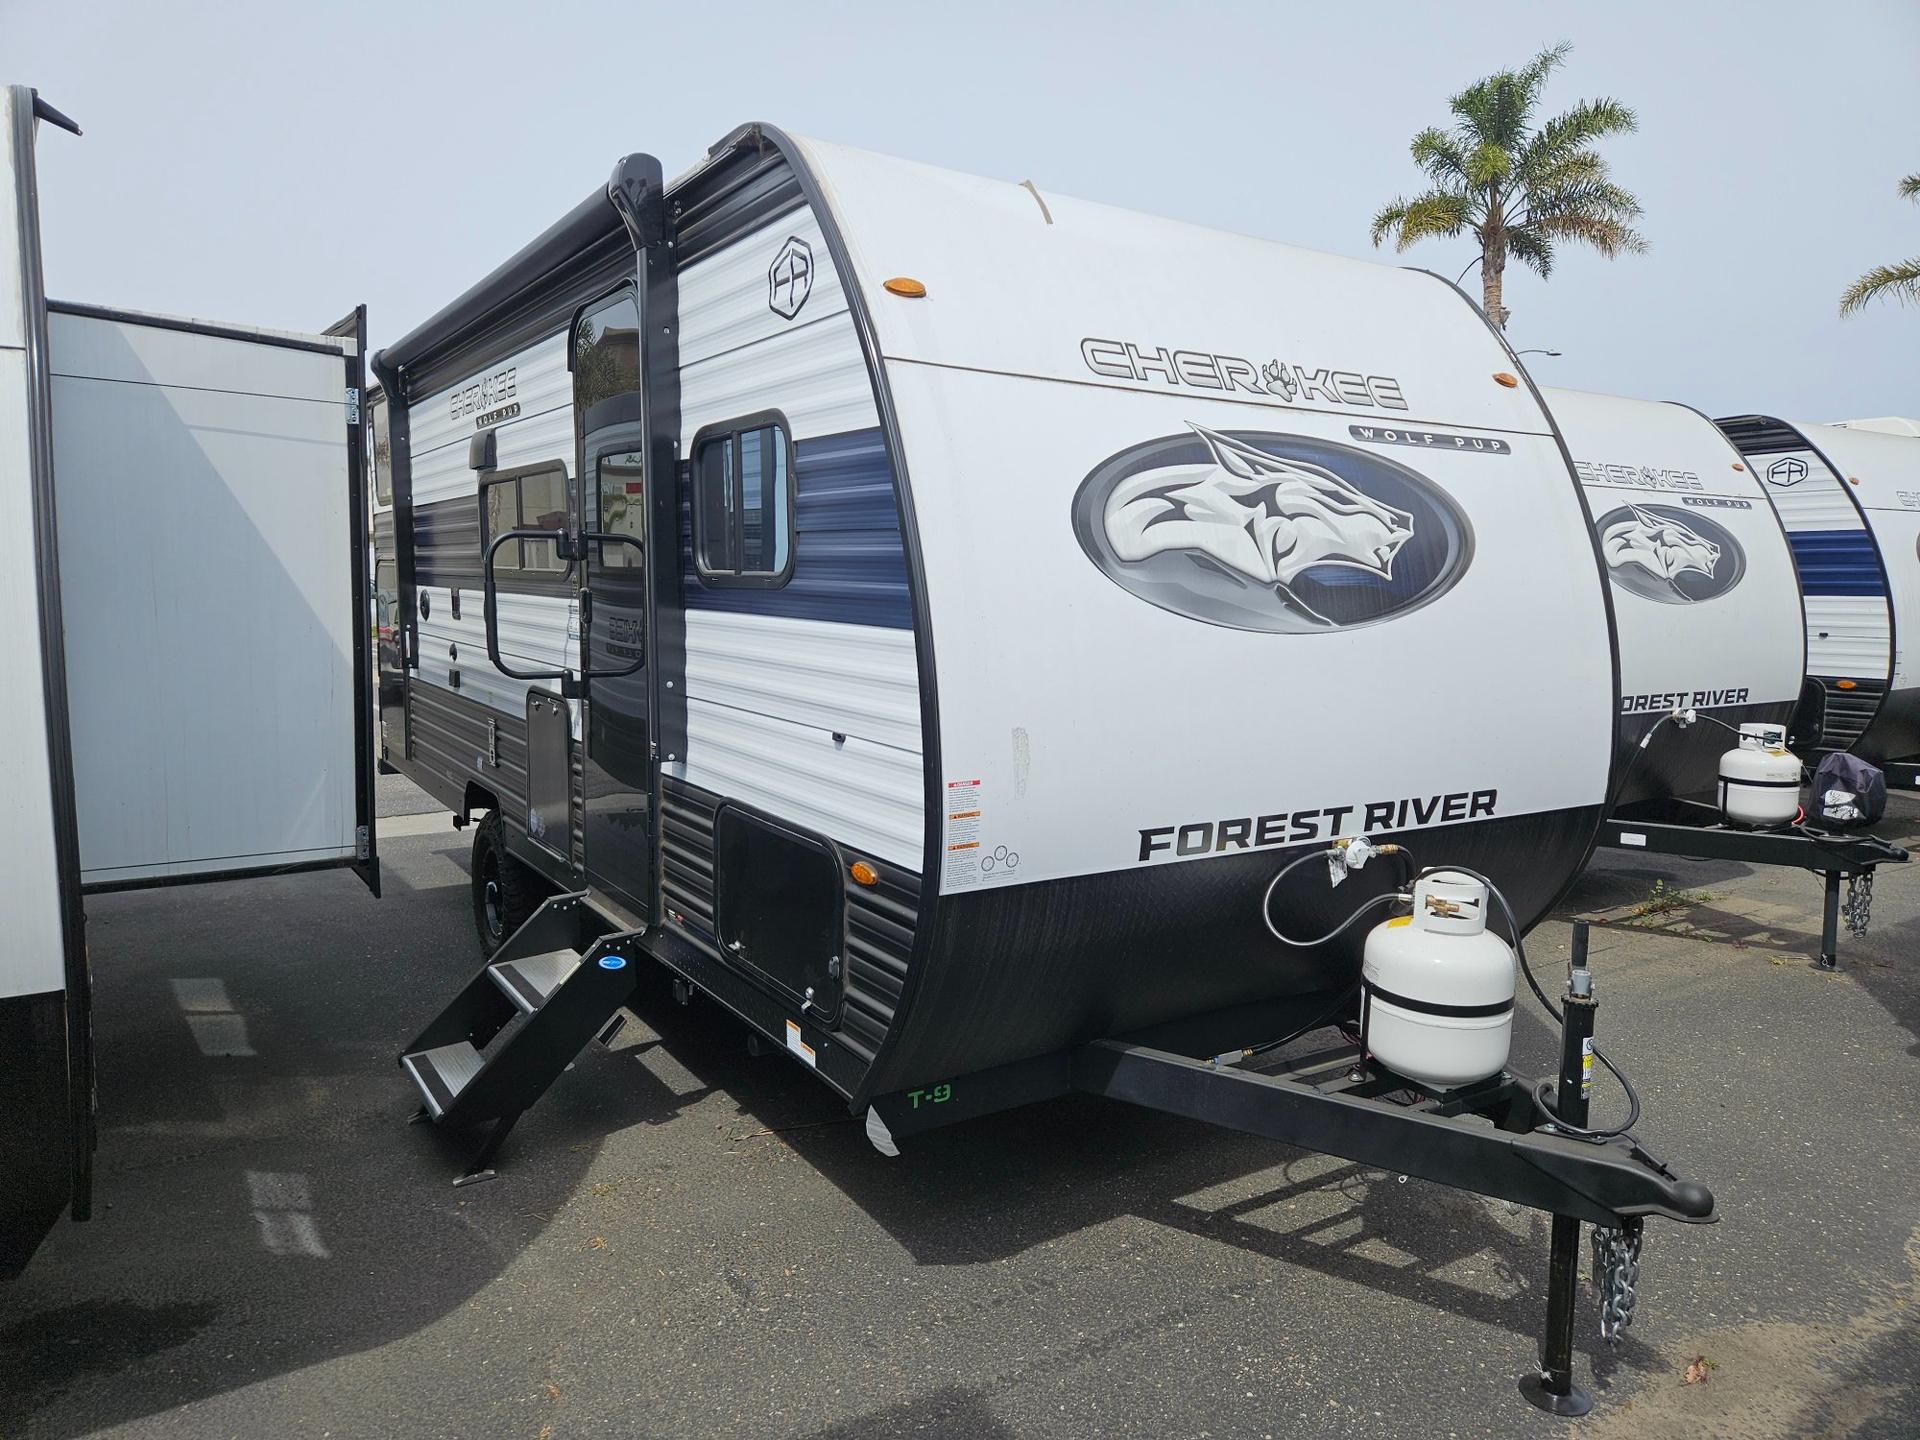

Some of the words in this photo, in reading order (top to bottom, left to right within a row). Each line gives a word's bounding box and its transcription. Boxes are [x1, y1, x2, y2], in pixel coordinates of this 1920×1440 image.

[477, 411, 498, 427] WOLF
[502, 404, 519, 418] PUP
[1358, 427, 1434, 445] WOLF
[1454, 437, 1501, 451] PUP
[1686, 499, 1719, 507] WOLF
[1727, 500, 1748, 509] PUP
[1621, 692, 1689, 712] OREST
[1692, 687, 1749, 707] RIVER
[1138, 805, 1355, 862] FOREST
[1363, 788, 1498, 832] RIVER
[907, 1083, 952, 1109] T-9
